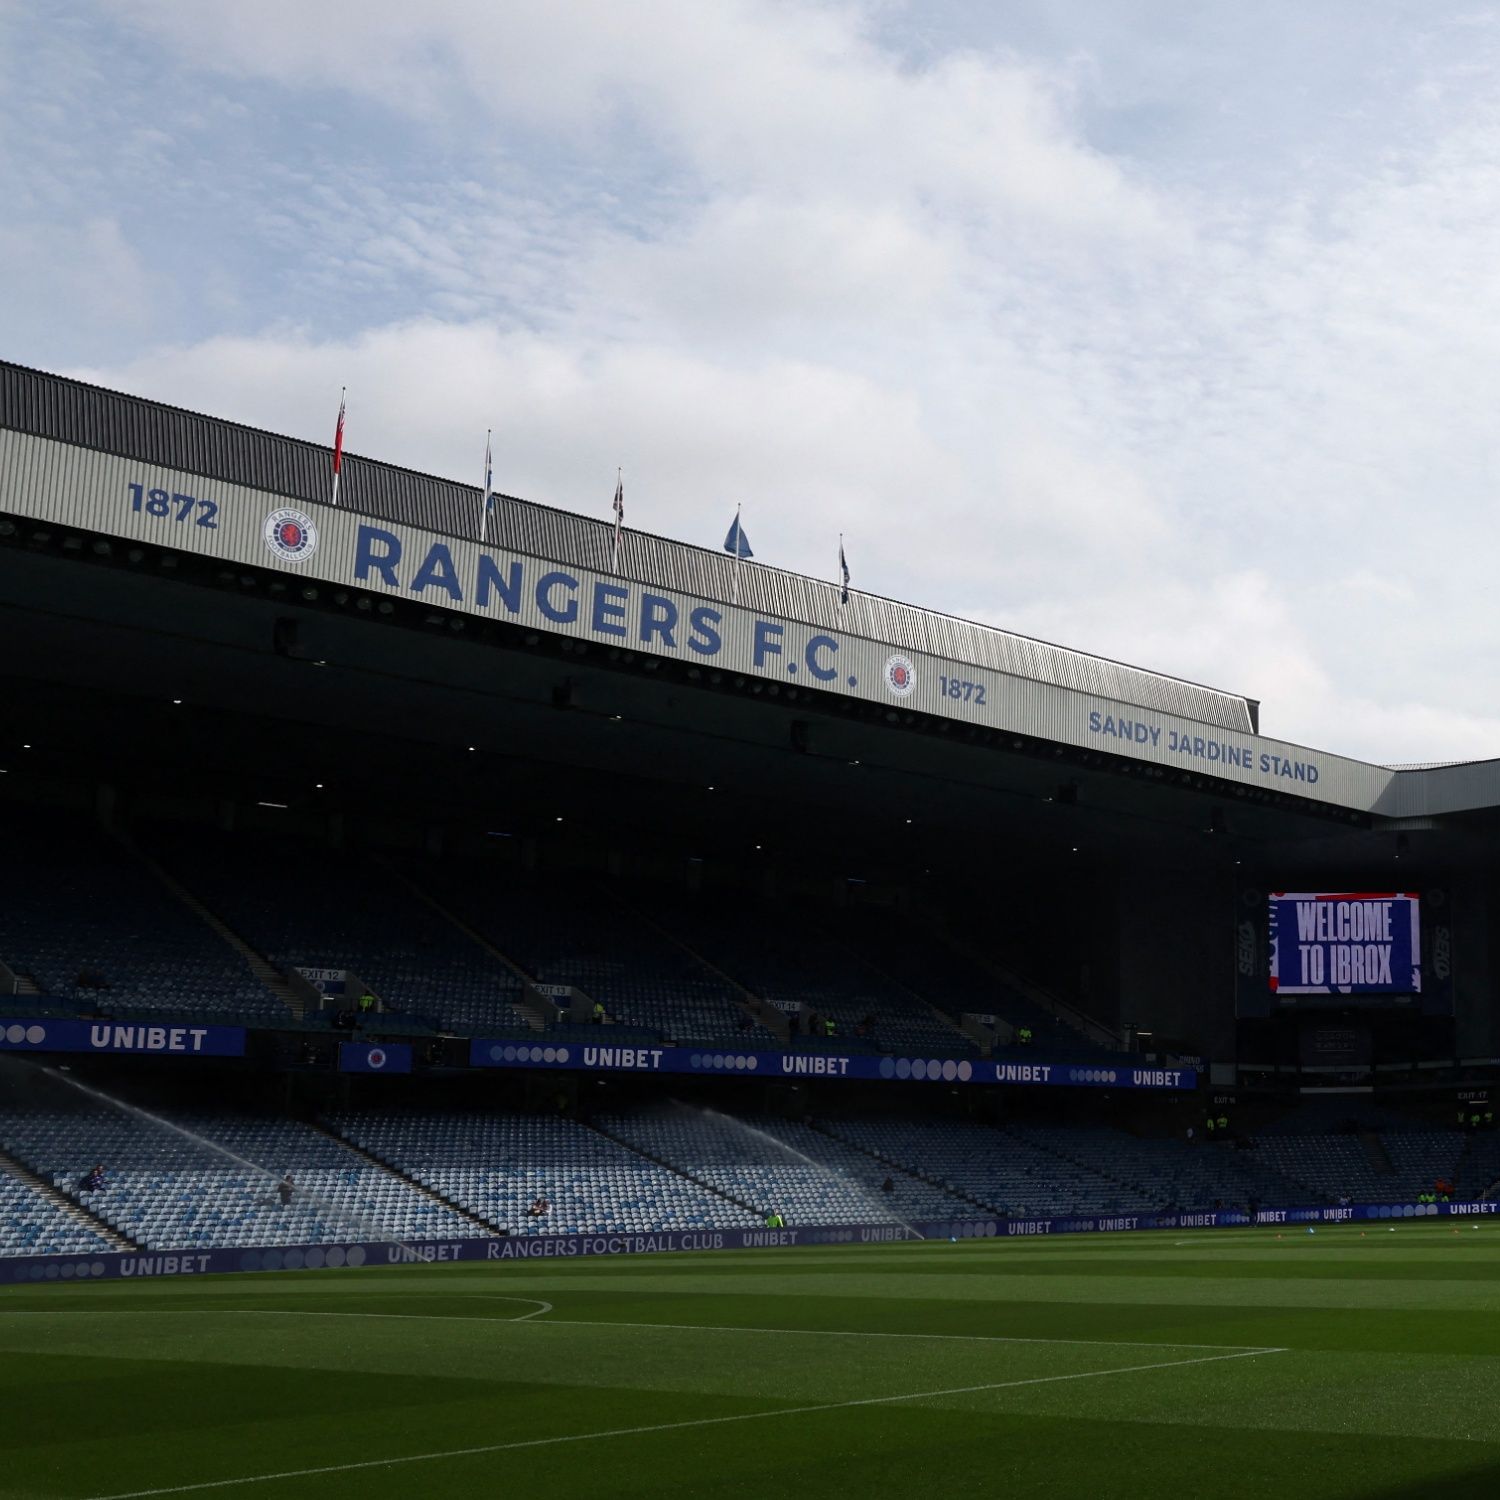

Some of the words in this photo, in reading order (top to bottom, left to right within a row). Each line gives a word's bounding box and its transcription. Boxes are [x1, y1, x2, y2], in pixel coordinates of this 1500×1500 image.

[129, 483, 218, 529] 1872
[355, 524, 722, 656] RANGERS
[753, 620, 857, 688] F.C.
[939, 675, 987, 705] 1872
[1089, 712, 1161, 746] SANDY
[1168, 731, 1253, 769] JARDINE
[1259, 753, 1319, 784] STAND
[1296, 902, 1394, 942] WELCOME
[1238, 921, 1257, 976] SEKO
[1432, 926, 1450, 980] SEKO
[301, 969, 324, 979] EXIT
[328, 971, 339, 980] 12
[1298, 945, 1324, 985] TO
[1330, 945, 1393, 985] IBROX
[91, 1025, 208, 1051] UNIBET
[583, 1047, 663, 1068] UNIBET
[782, 1055, 850, 1075] UNIBET
[996, 1064, 1051, 1082] UNIBET
[1133, 1070, 1181, 1086] UNIBET
[1324, 1208, 1353, 1220] UNIBET
[1450, 1203, 1497, 1214] UNIBET
[1008, 1221, 1051, 1235] UNIBET
[1098, 1217, 1138, 1231] UNIBET
[1180, 1213, 1217, 1227] UNIBET
[743, 1231, 798, 1247] UNIBET
[862, 1228, 911, 1242] UNIBET
[388, 1243, 462, 1263] UNIBET
[487, 1236, 578, 1260] RANGERS
[583, 1233, 676, 1255] FOOTBALL
[681, 1233, 723, 1251] CLUB
[120, 1255, 211, 1276] UNIBET
